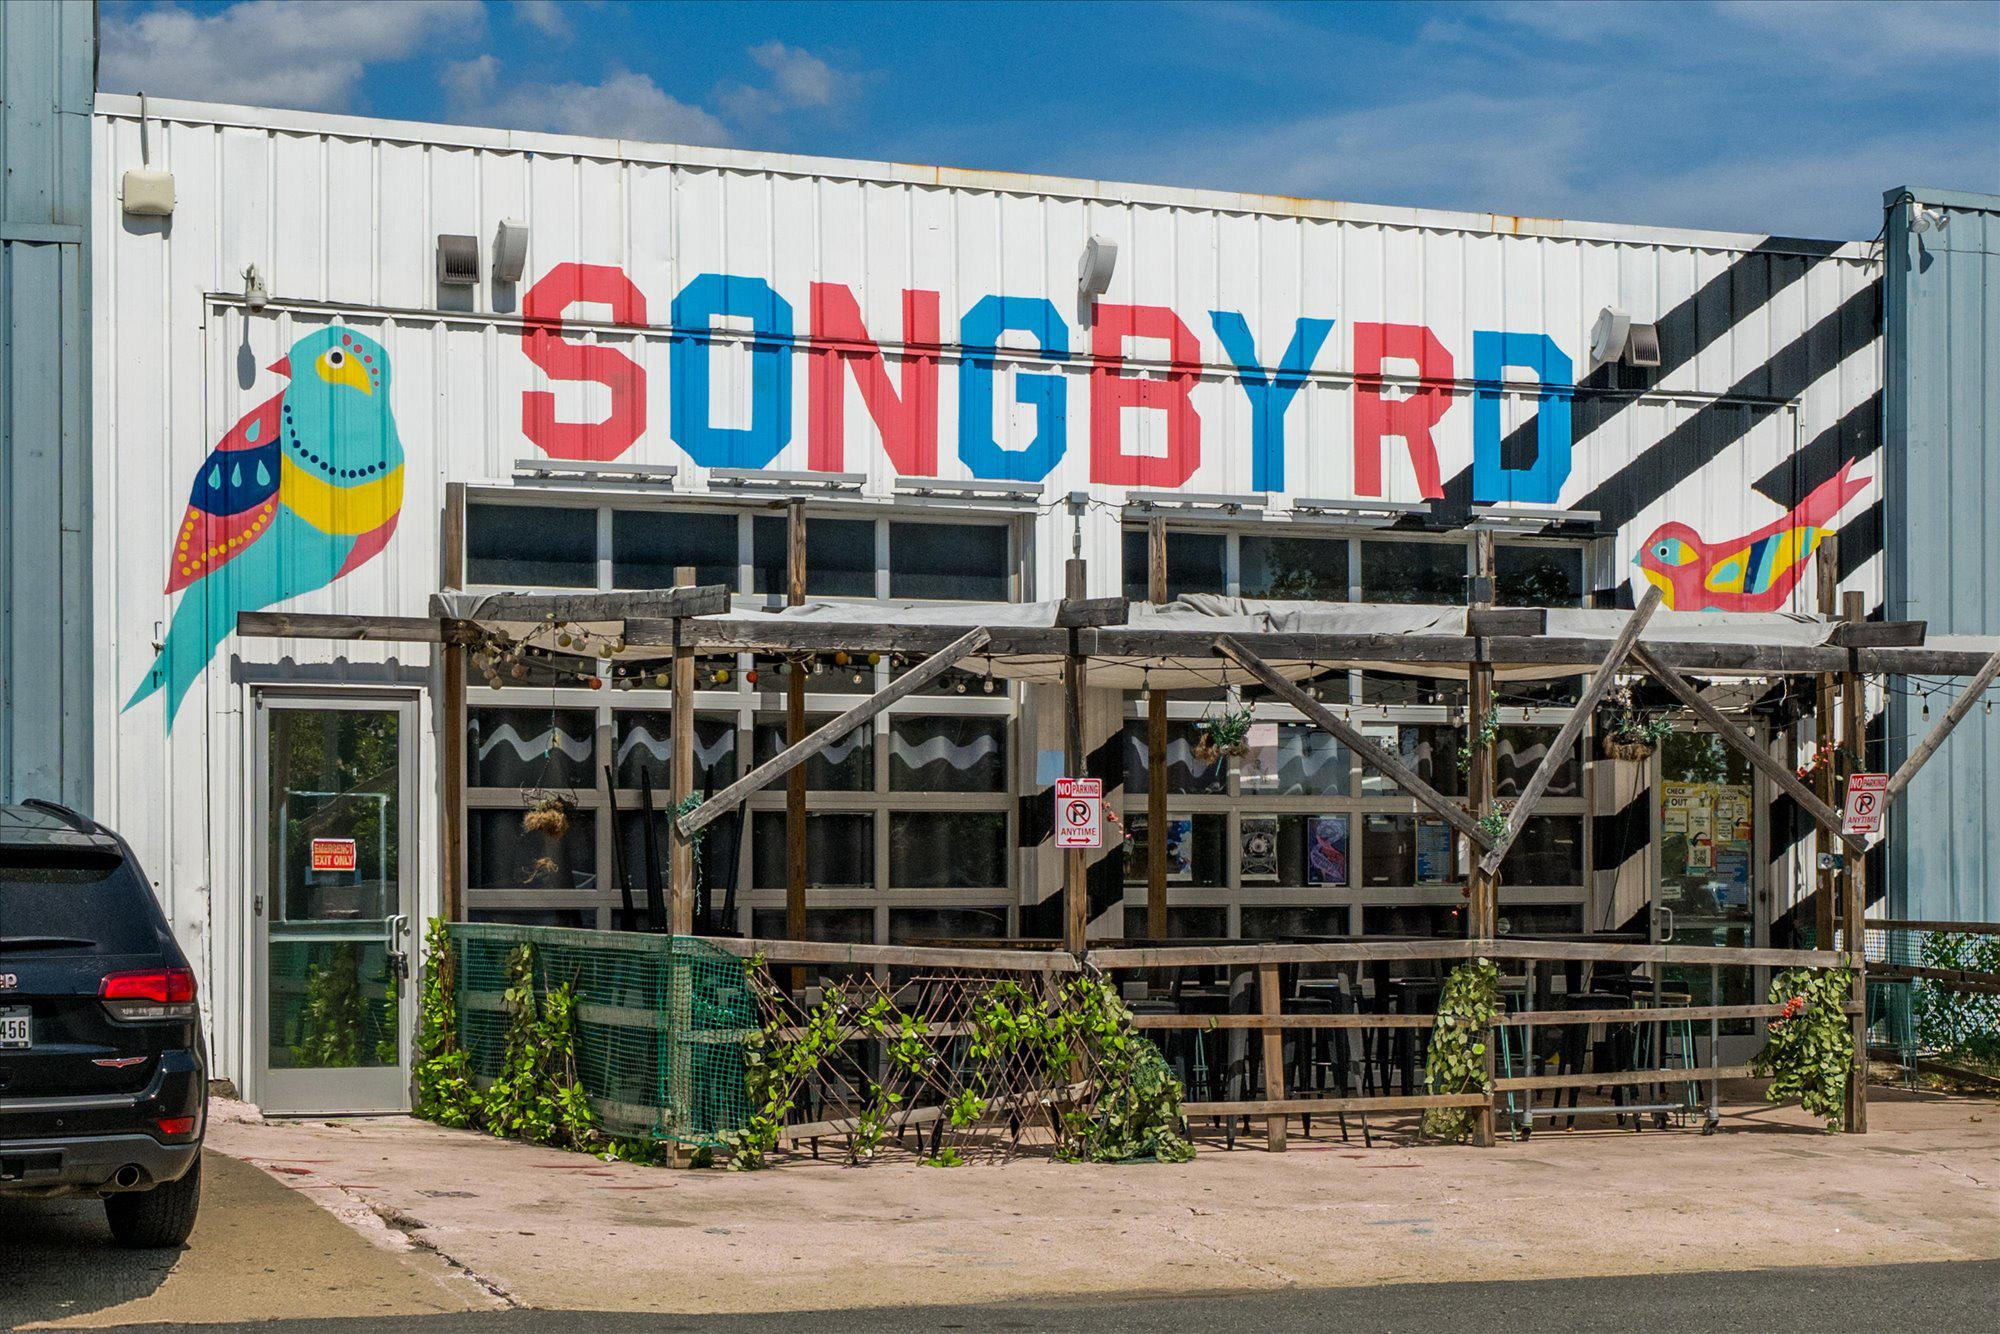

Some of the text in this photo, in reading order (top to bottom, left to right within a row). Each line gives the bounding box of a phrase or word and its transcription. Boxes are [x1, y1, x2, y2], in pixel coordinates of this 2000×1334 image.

[522, 263, 1573, 503] SONGBYRD
[1851, 777, 1886, 788] NO PARKING
[1057, 782, 1098, 795] NO PARKING
[1671, 798, 1688, 806] OUT
[1847, 815, 1879, 824] ANYTIME
[1061, 827, 1097, 836] ANYTIME
[314, 843, 353, 854] EMERGENCY
[314, 854, 353, 866] EXIT ONLY
